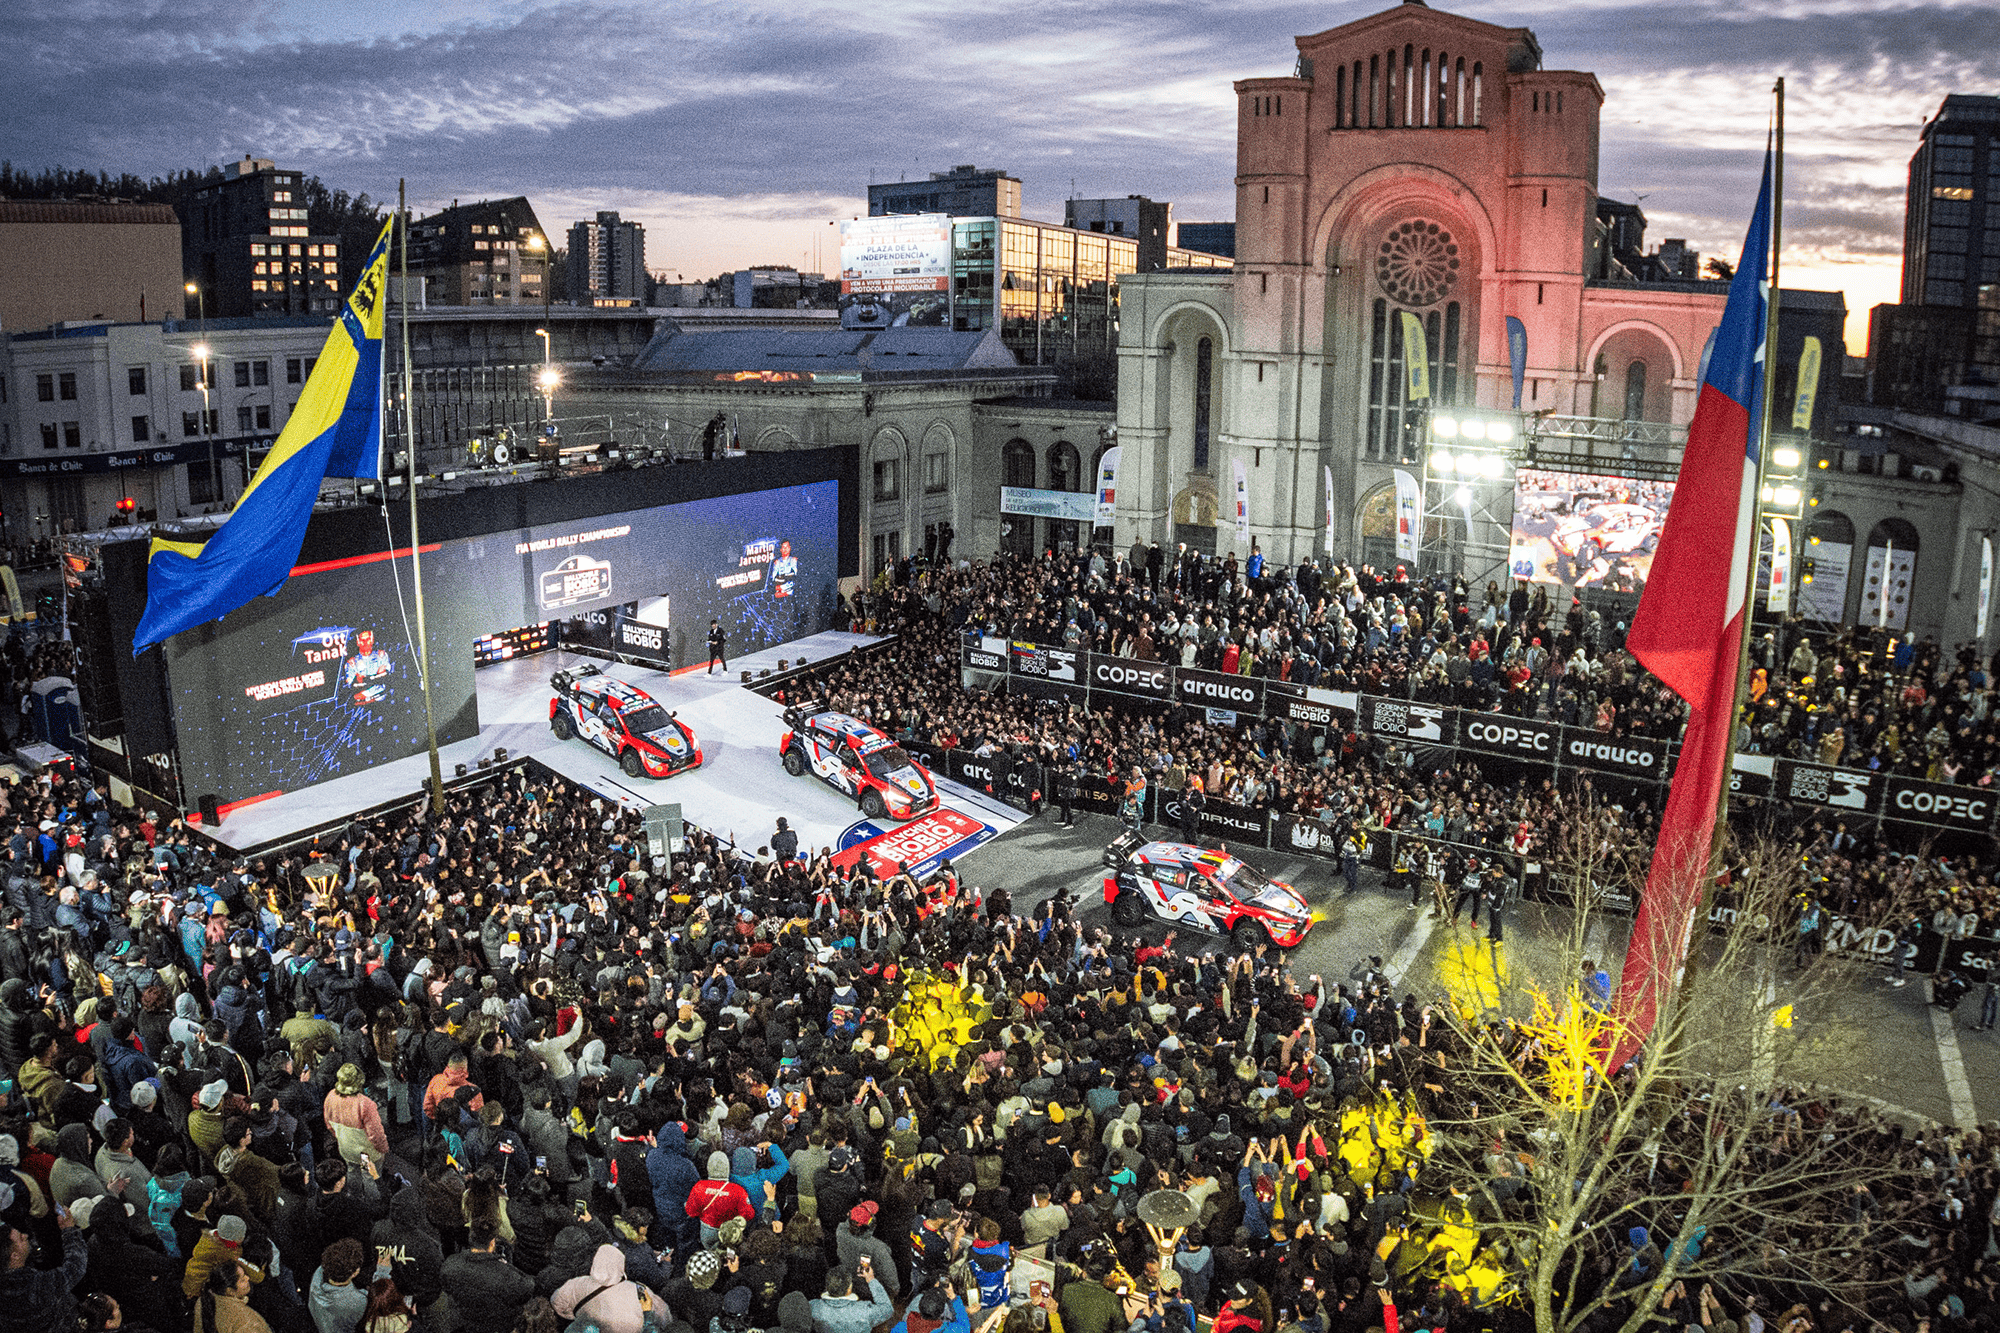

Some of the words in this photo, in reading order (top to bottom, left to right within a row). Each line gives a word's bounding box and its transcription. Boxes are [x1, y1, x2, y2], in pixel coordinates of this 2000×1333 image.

[861, 251, 925, 262] INDEPENDENCIA
[867, 245, 893, 253] PLAZA
[895, 244, 906, 252] DE
[850, 285, 893, 293] PROTOCOLAR
[894, 284, 937, 292] INOLVIDABLE
[18, 461, 47, 474] Banco
[49, 462, 59, 472] de
[60, 460, 84, 471] Chile
[108, 456, 137, 467] Banco
[153, 451, 176, 463] Chile
[515, 542, 530, 555] FIA
[529, 538, 556, 552] WORLD
[556, 534, 579, 547] RALLY
[579, 525, 631, 543] CHAMPIONSHIP
[745, 543, 775, 556] Martin
[622, 624, 662, 638] RALLYCHILE
[322, 632, 347, 648] Ott
[622, 632, 662, 650] BIOBIO
[303, 644, 348, 664] Tanak
[969, 651, 999, 663] RALLYCHILE
[970, 657, 999, 668] BIOBIO
[1097, 664, 1165, 690] COPEC
[1183, 678, 1255, 703] arauco
[1289, 702, 1331, 715] RALLYCHILE
[1289, 708, 1331, 723] BIOBIO
[1468, 722, 1550, 751] COPEC
[1570, 740, 1654, 767] arauco
[1896, 789, 1988, 821] COPEC
[1199, 811, 1262, 832] MAXUS
[869, 818, 939, 854] RALLYCHILE
[882, 825, 954, 863] BIOBIO
